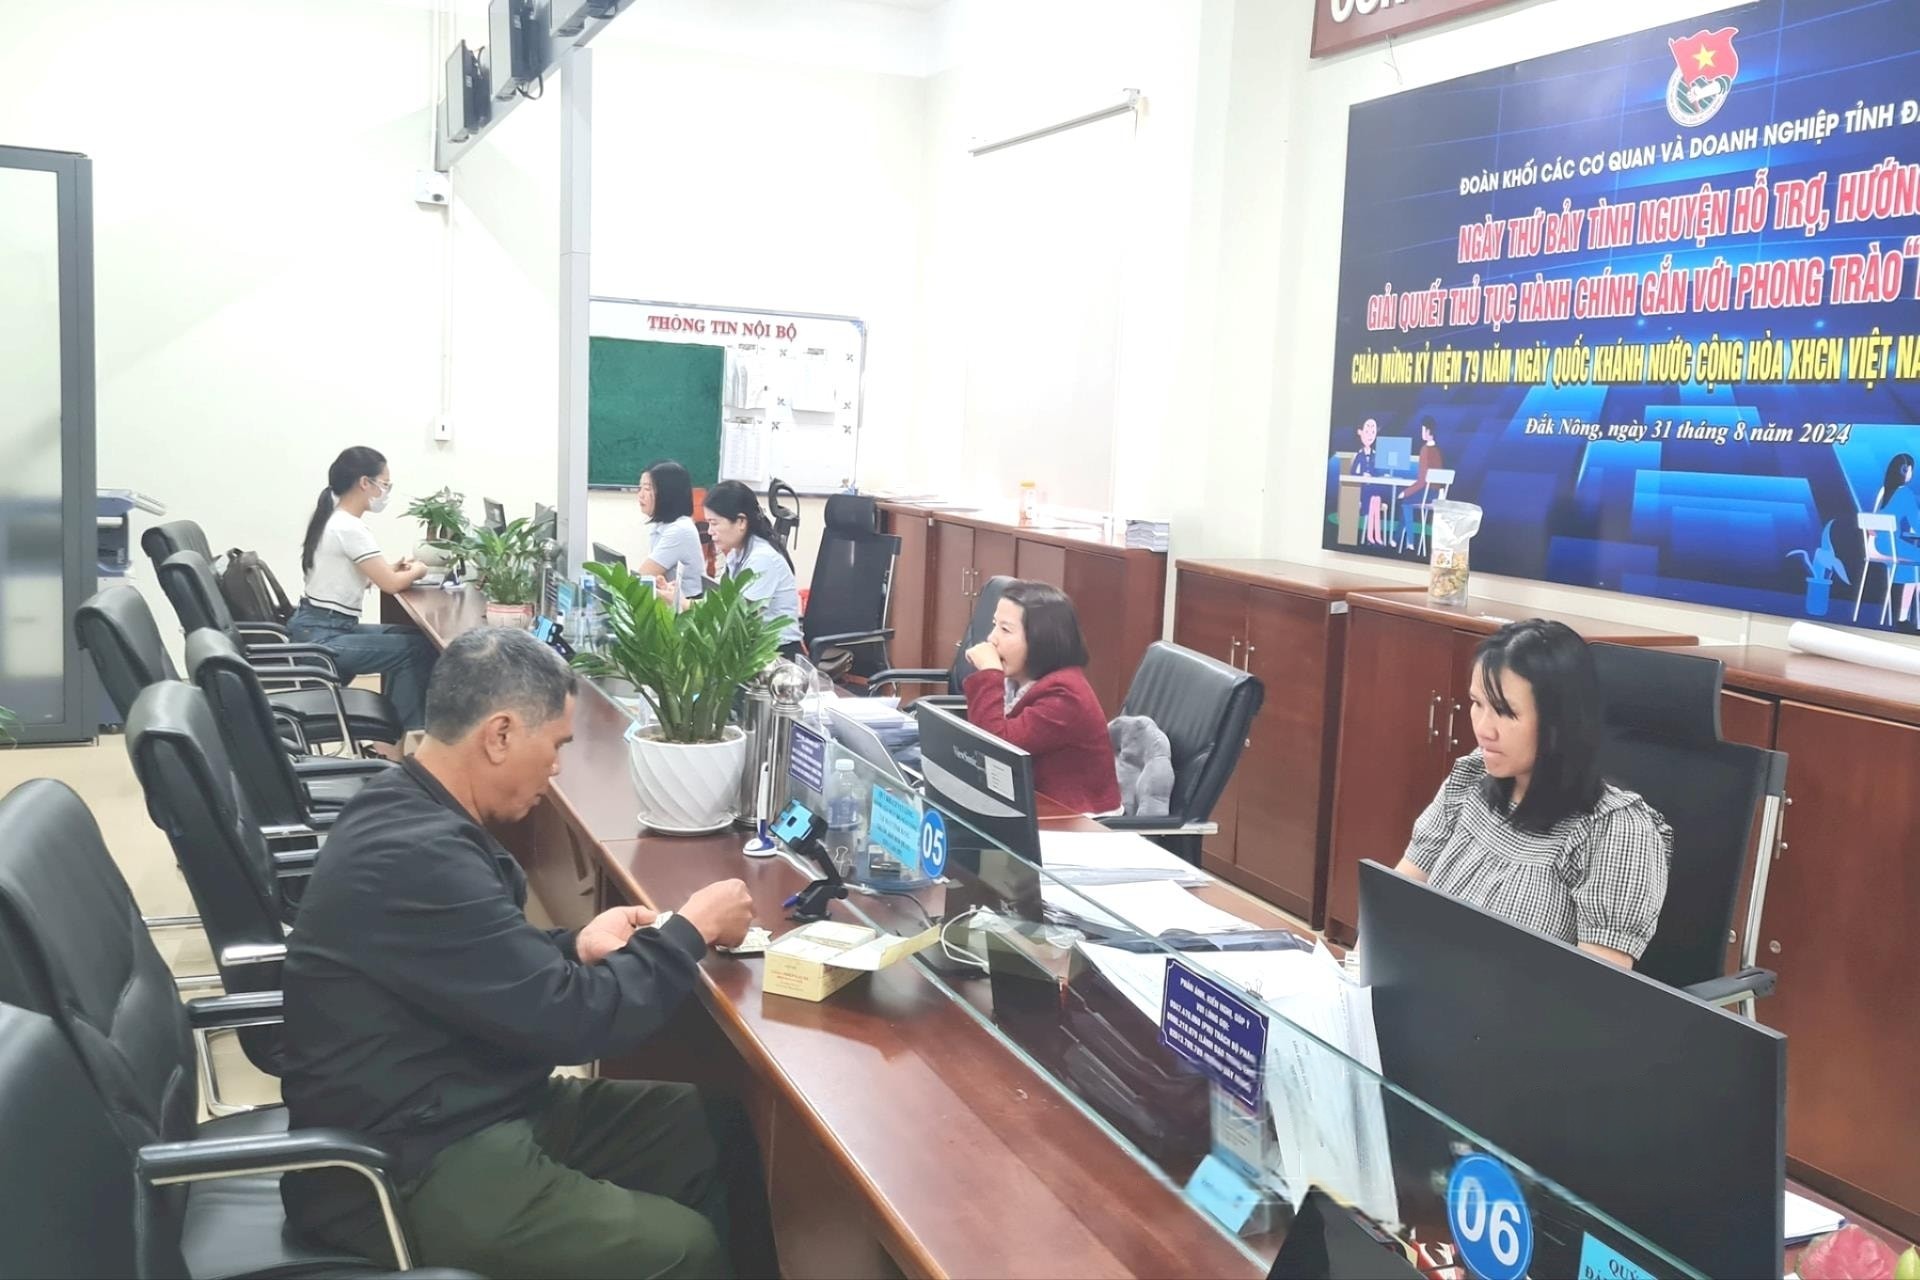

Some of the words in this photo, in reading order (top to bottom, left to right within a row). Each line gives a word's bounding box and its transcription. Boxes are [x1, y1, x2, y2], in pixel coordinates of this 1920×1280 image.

[1460, 168, 1499, 195] ĐOÀN
[1502, 158, 1538, 189] KHỐI
[1541, 156, 1575, 183] CÁC
[1579, 151, 1605, 176] CƠ
[1609, 145, 1656, 172] QUAN
[1660, 135, 1685, 163] VÀ
[1689, 127, 1759, 159] DOANH
[1763, 108, 1840, 145] NGHIỆP
[1844, 100, 1895, 134] TỈNH
[1458, 214, 1505, 264] NGÀY
[1508, 207, 1546, 259] THỨ
[1544, 198, 1585, 255] BẢY
[1587, 197, 1635, 250] TÌNH
[1637, 182, 1730, 247] NGUYỆN
[1732, 167, 1769, 234] HỖ
[1773, 171, 1830, 237] TRỢ,
[1367, 282, 1398, 331] GIẢI
[1399, 278, 1448, 332] QUYẾT
[1449, 274, 1481, 326] THỦ
[1484, 284, 1517, 332] TỤC
[1519, 273, 1572, 322] HÀNH
[1574, 267, 1638, 319] CHÍNH
[1641, 253, 1690, 315] GẮN
[1693, 256, 1732, 313] VỚI
[1735, 257, 1824, 310] PHONG
[1830, 241, 1904, 304] TRÀO
[647, 313, 705, 333] THÔNG
[710, 320, 738, 335] TIN
[742, 319, 771, 340] NỘI
[775, 322, 797, 342] BỘ
[1352, 347, 1378, 384] CHÀO
[1380, 346, 1413, 384] MỪNG
[1414, 341, 1430, 384] KỶ
[1431, 343, 1462, 390] NIỆM
[1464, 351, 1480, 384] 79
[1481, 343, 1512, 384] NĂM
[1513, 339, 1551, 384] NGÀY
[1552, 333, 1590, 388] QUỐC
[1593, 337, 1645, 382] KHÁNH
[1647, 334, 1692, 382] NƯỚC
[1696, 333, 1743, 391] CỘNG
[1747, 330, 1784, 381] HÒA
[1788, 337, 1844, 381] XHCN
[1848, 327, 1893, 389] VIỆT
[1524, 411, 1554, 435] Đắk
[1558, 418, 1604, 440] Nông,
[1607, 420, 1648, 442] ngày
[1651, 420, 1673, 439] 31
[1676, 420, 1729, 446] tháng
[1733, 421, 1746, 441] 8
[1750, 422, 1793, 442] năm
[1798, 423, 1852, 444] 2024
[923, 822, 944, 866] 05
[1457, 1176, 1521, 1266] 06
